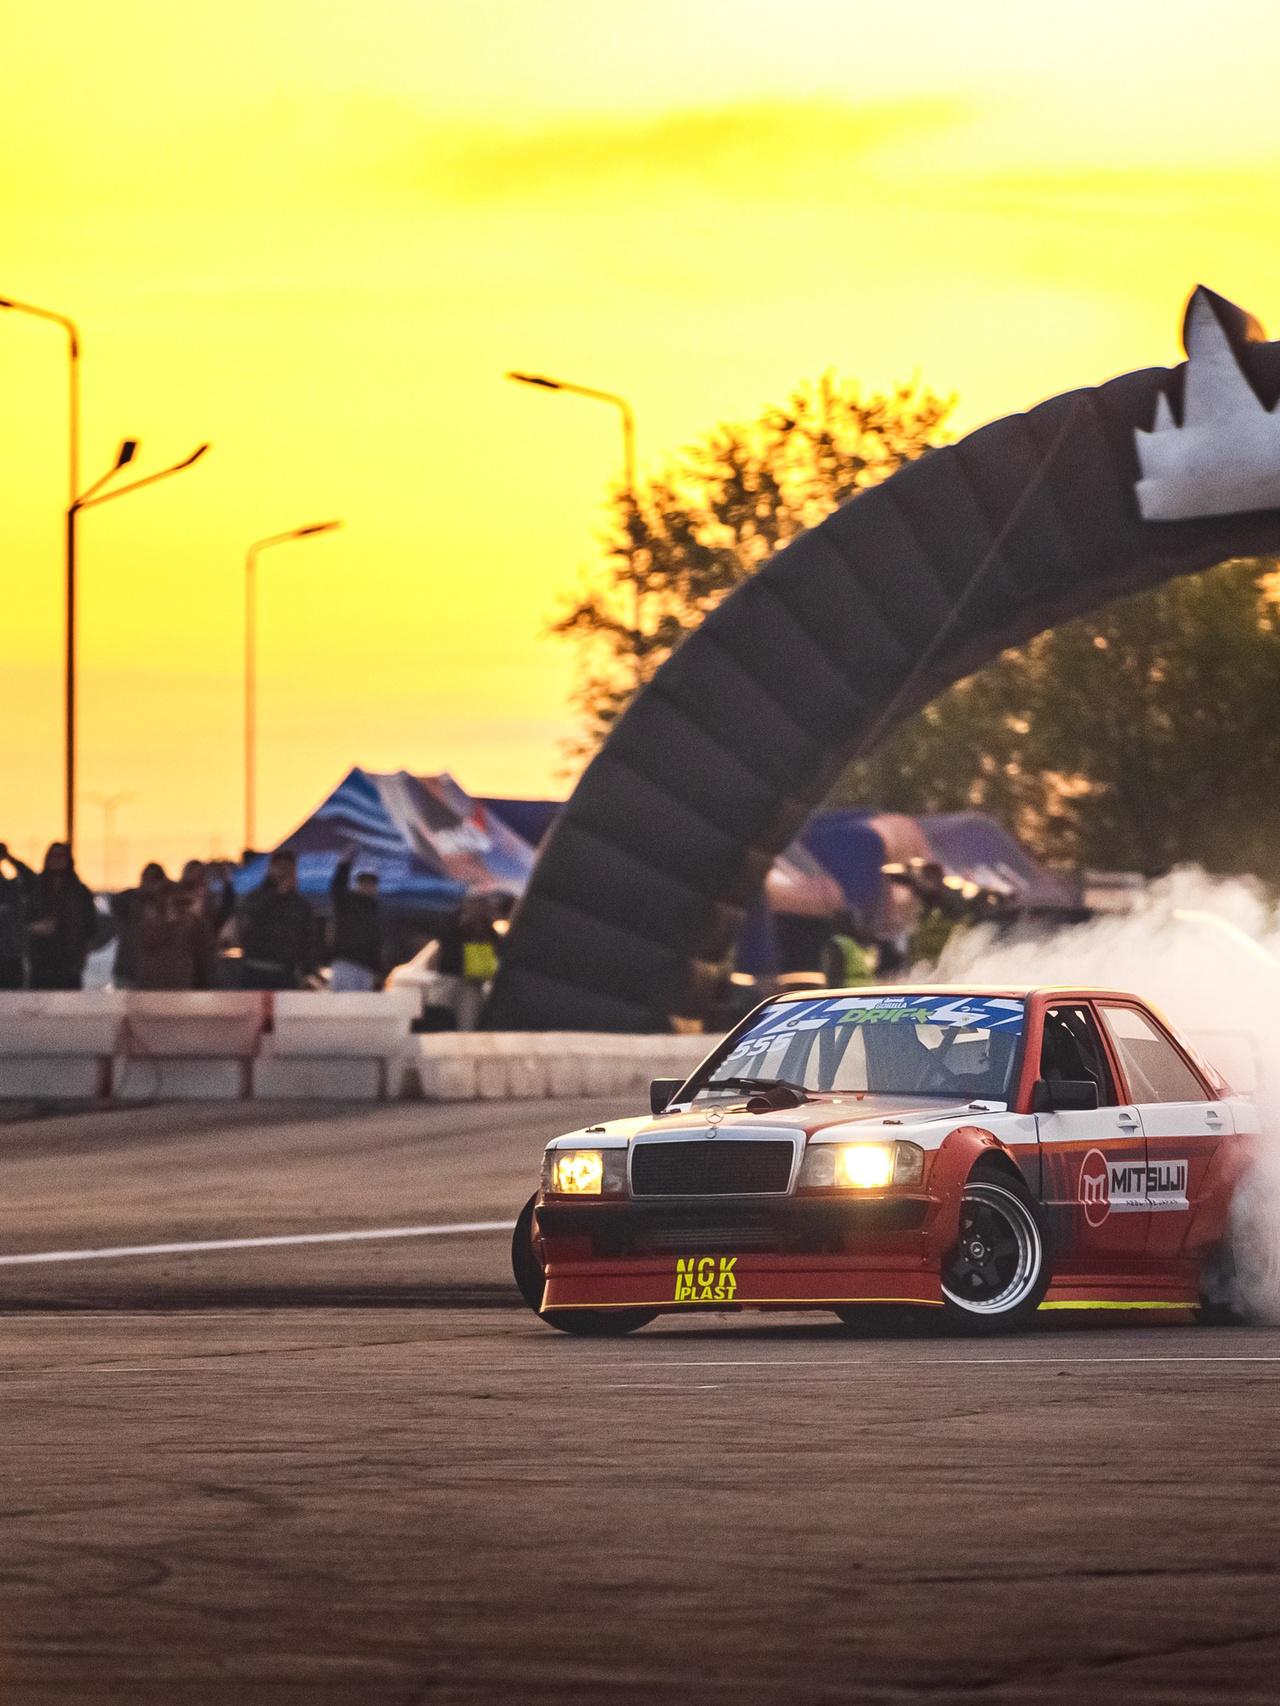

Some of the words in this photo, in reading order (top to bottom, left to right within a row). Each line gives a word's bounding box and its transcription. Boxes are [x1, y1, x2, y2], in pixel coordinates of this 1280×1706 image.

[874, 1002, 908, 1010] GORILLA
[836, 1007, 934, 1024] DRIFT
[726, 1031, 797, 1060] 555
[1111, 1166, 1185, 1193] MITSUJI
[680, 1286, 737, 1301] PLAST
